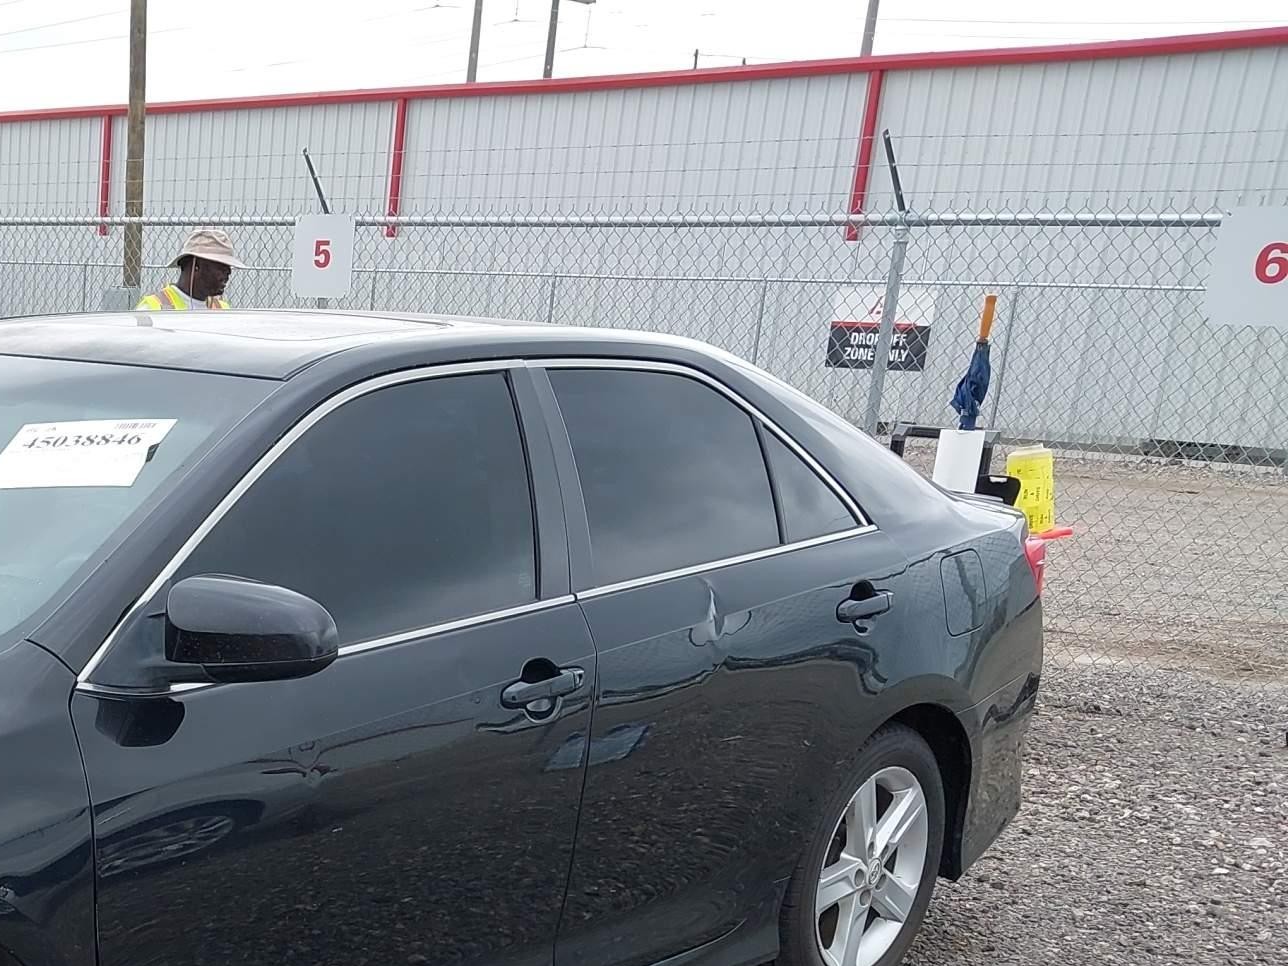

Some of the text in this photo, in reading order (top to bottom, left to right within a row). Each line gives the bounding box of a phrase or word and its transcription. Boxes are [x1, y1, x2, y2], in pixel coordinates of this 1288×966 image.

[314, 240, 331, 268] 5
[1255, 242, 1288, 284] 6
[843, 347, 875, 361] ZONE
[22, 433, 144, 449] 45038846
